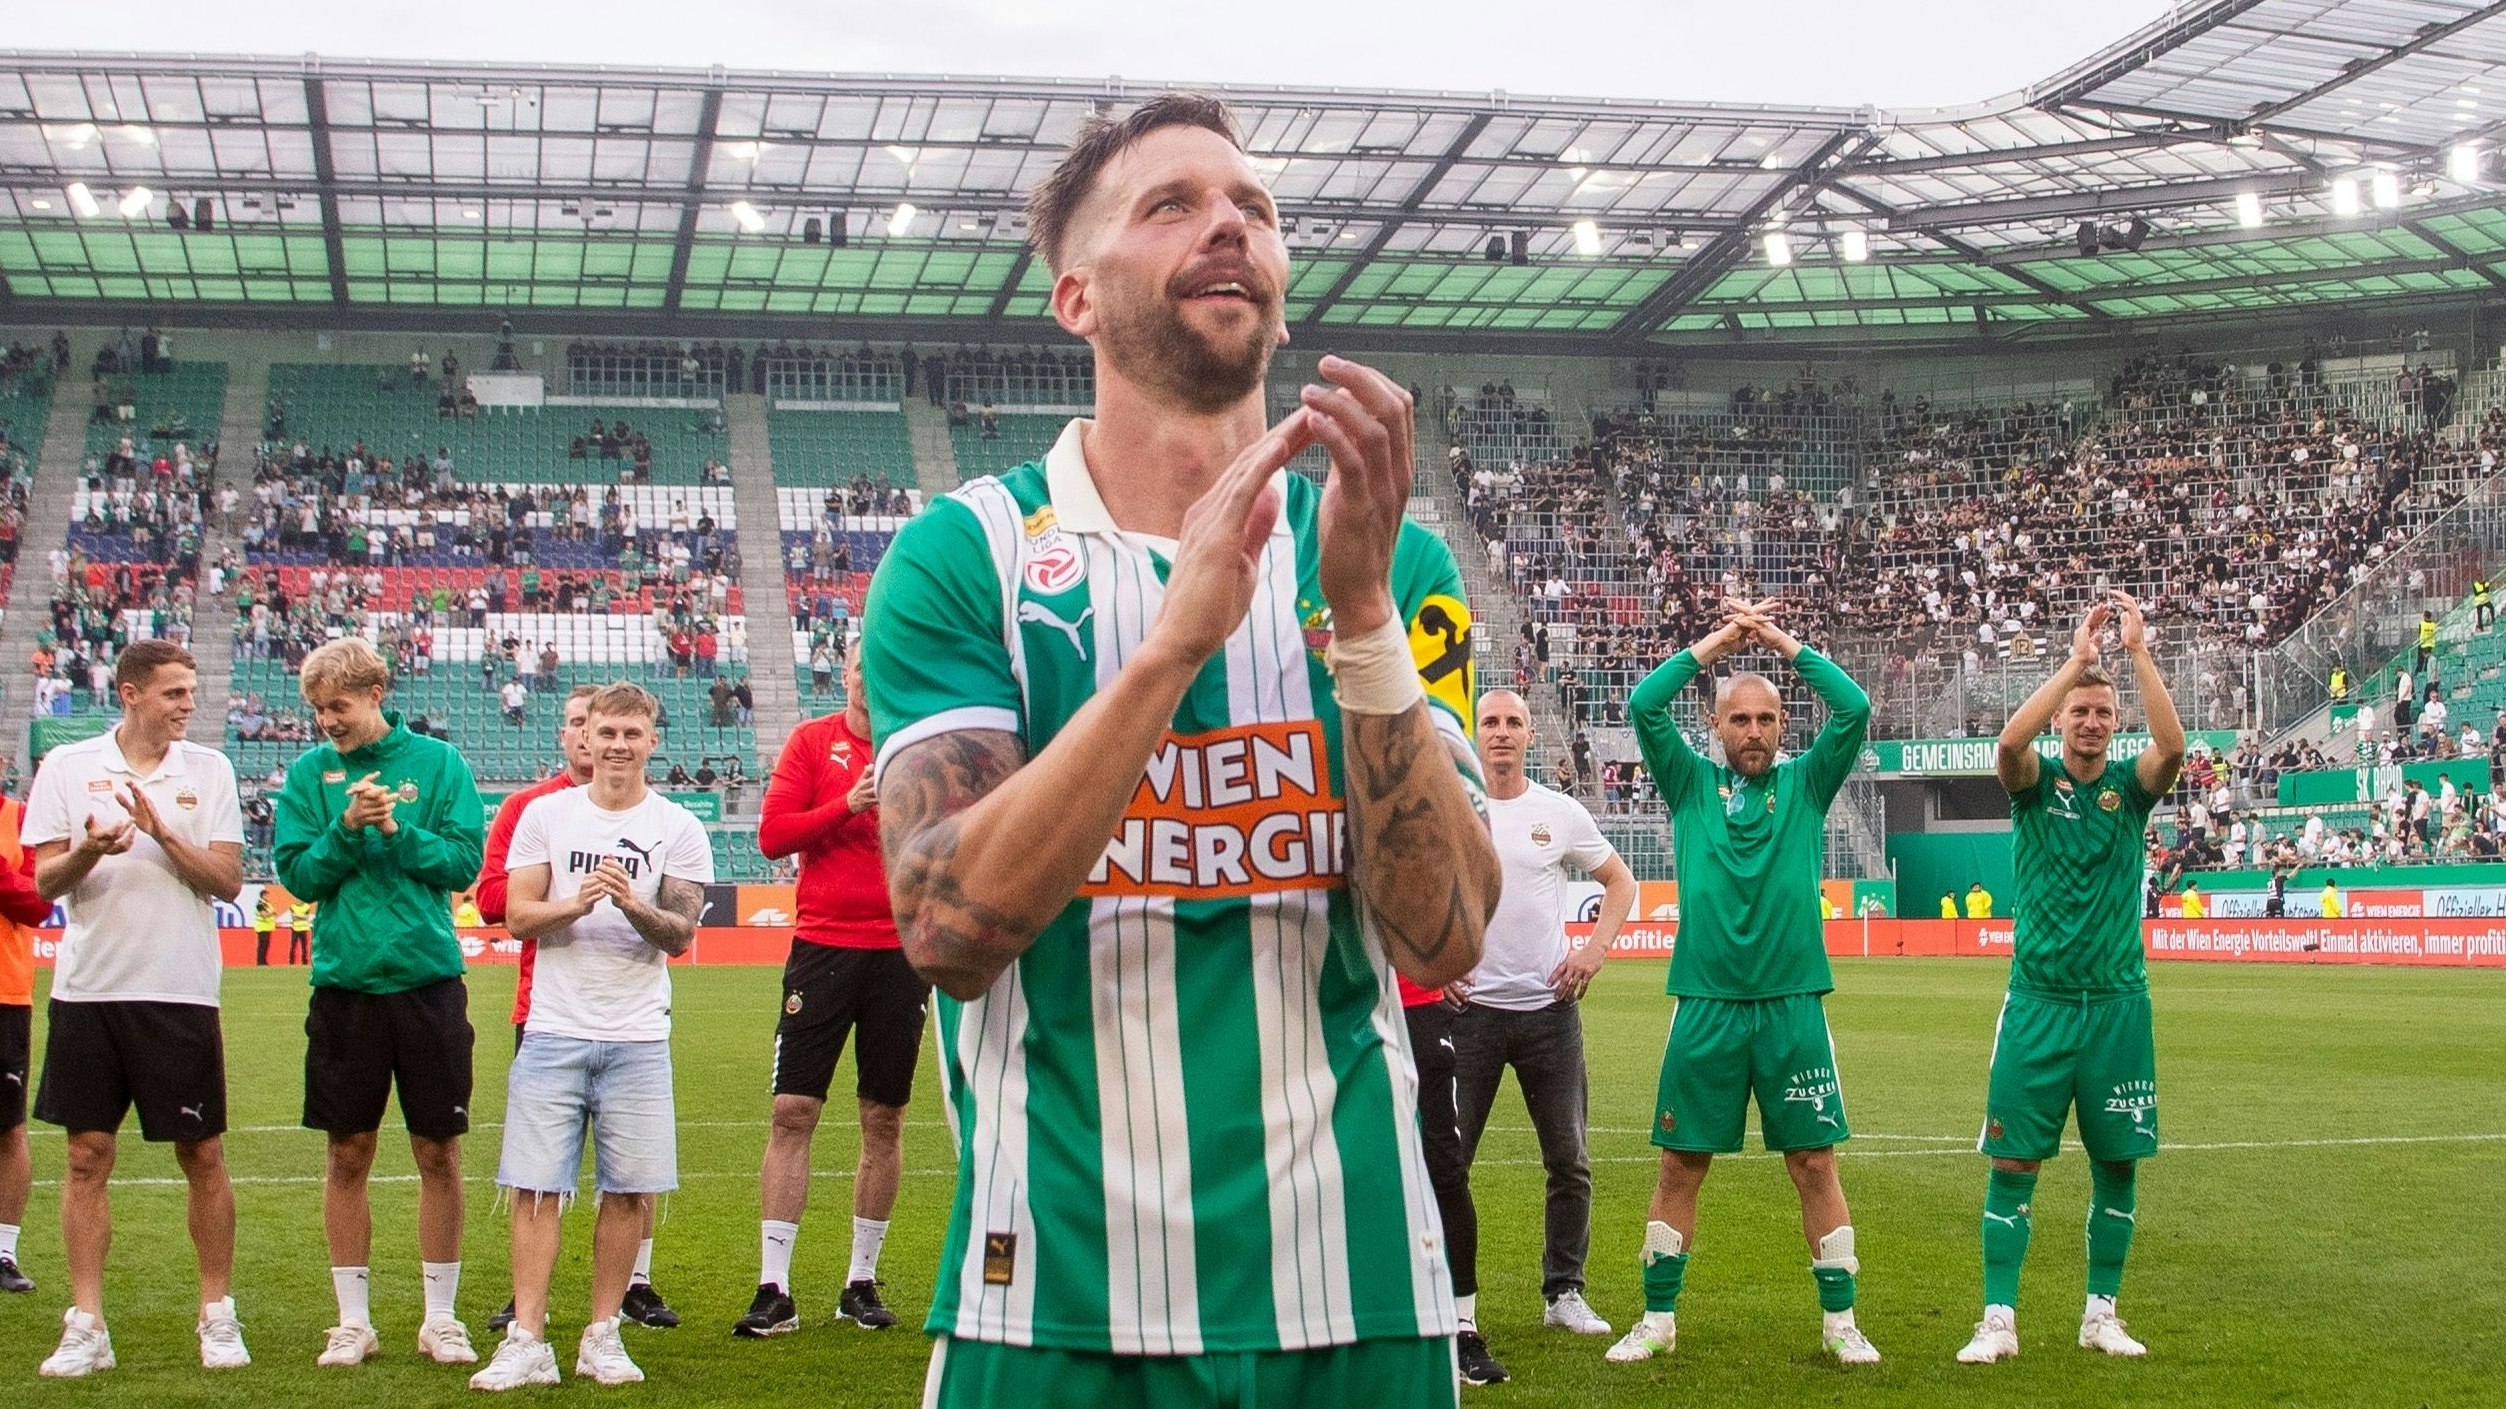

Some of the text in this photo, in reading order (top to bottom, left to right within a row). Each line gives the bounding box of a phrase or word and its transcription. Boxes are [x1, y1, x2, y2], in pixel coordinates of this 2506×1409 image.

[1033, 536, 1062, 553] LIGA
[1902, 743, 1999, 771] GEMEINSAM
[2356, 768, 2370, 801] SK
[569, 850, 639, 880] PUA
[2365, 904, 2388, 918] WIEN
[2436, 895, 2492, 917] Offizieller
[1611, 930, 1676, 951] rofitie
[2152, 928, 2506, 960] Mit der Wien Energie Vorteilswelt! Einmal aktivieren, immer profiti
